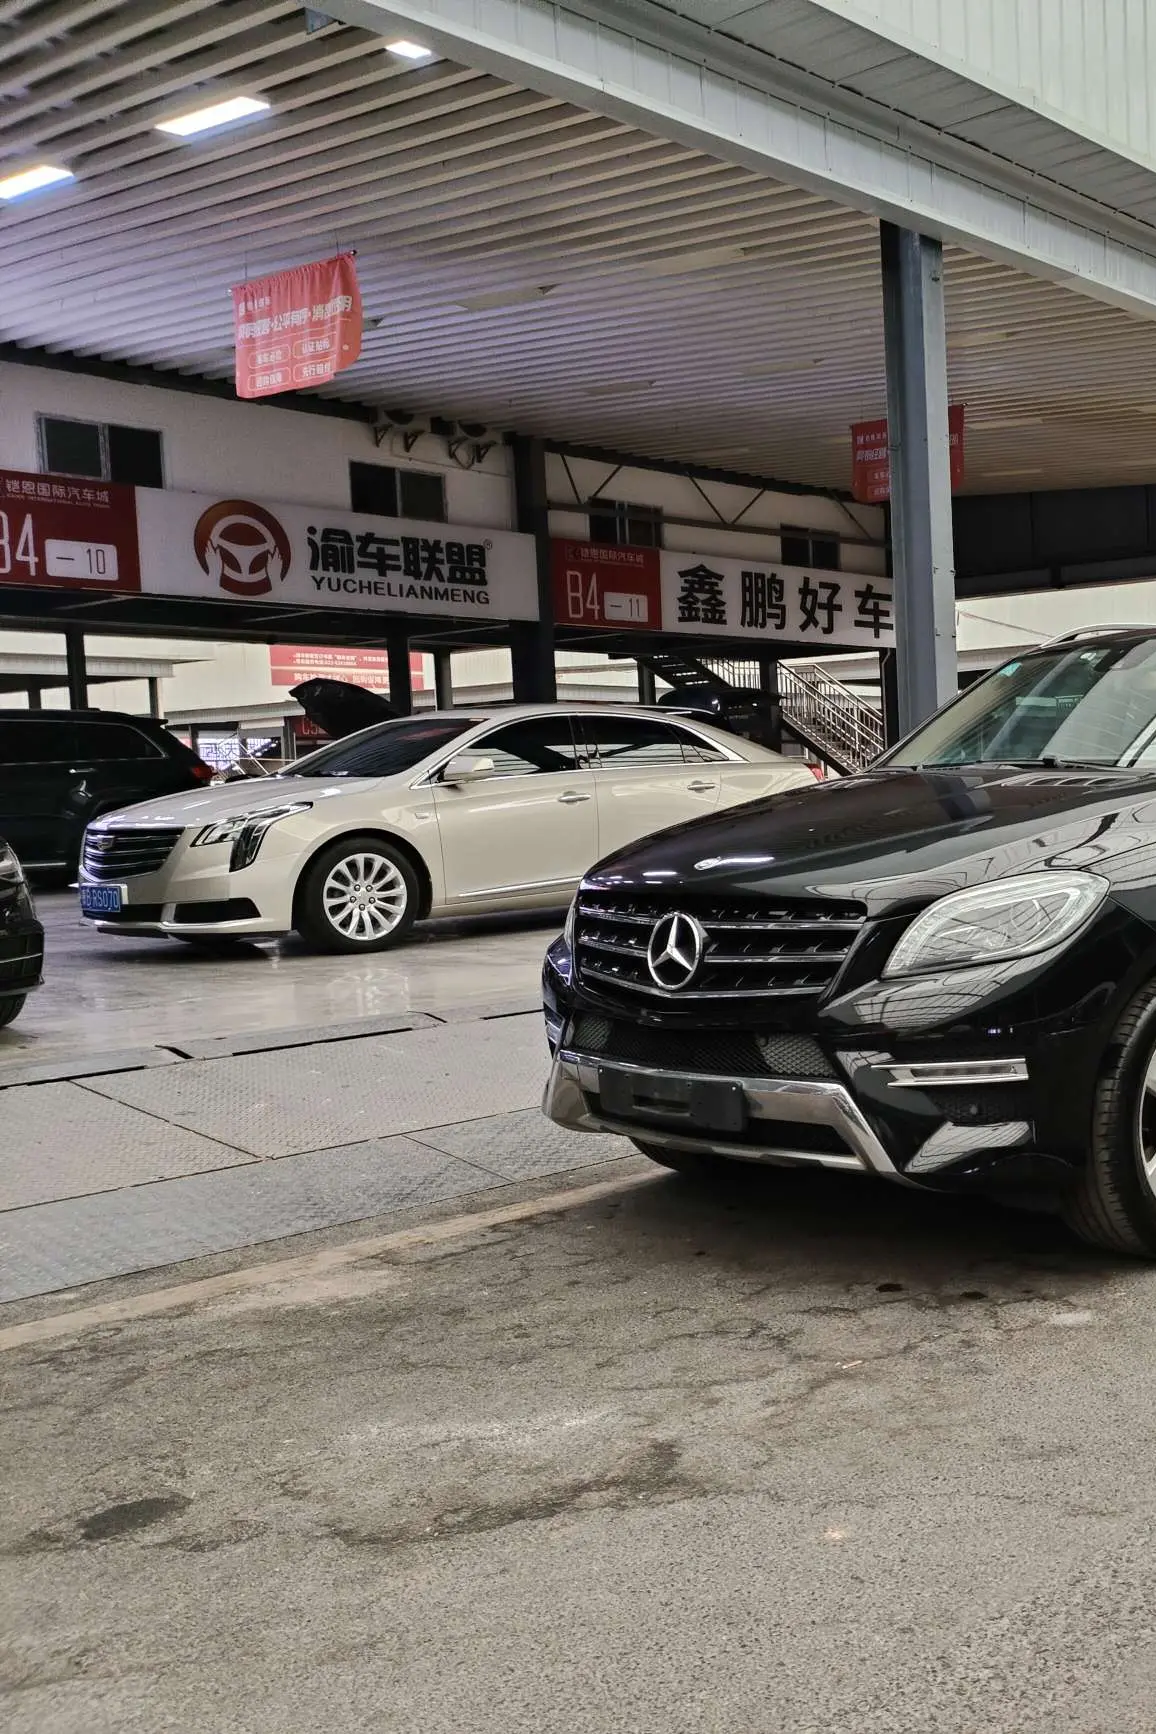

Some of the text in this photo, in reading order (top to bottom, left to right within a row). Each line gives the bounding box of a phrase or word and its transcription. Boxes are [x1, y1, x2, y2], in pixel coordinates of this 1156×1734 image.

[307, 525, 488, 586] 渝车联盟
[311, 575, 490, 605] YUCHELIANMENG
[566, 570, 600, 620] B4
[677, 563, 894, 640] 鑫鹏好车
